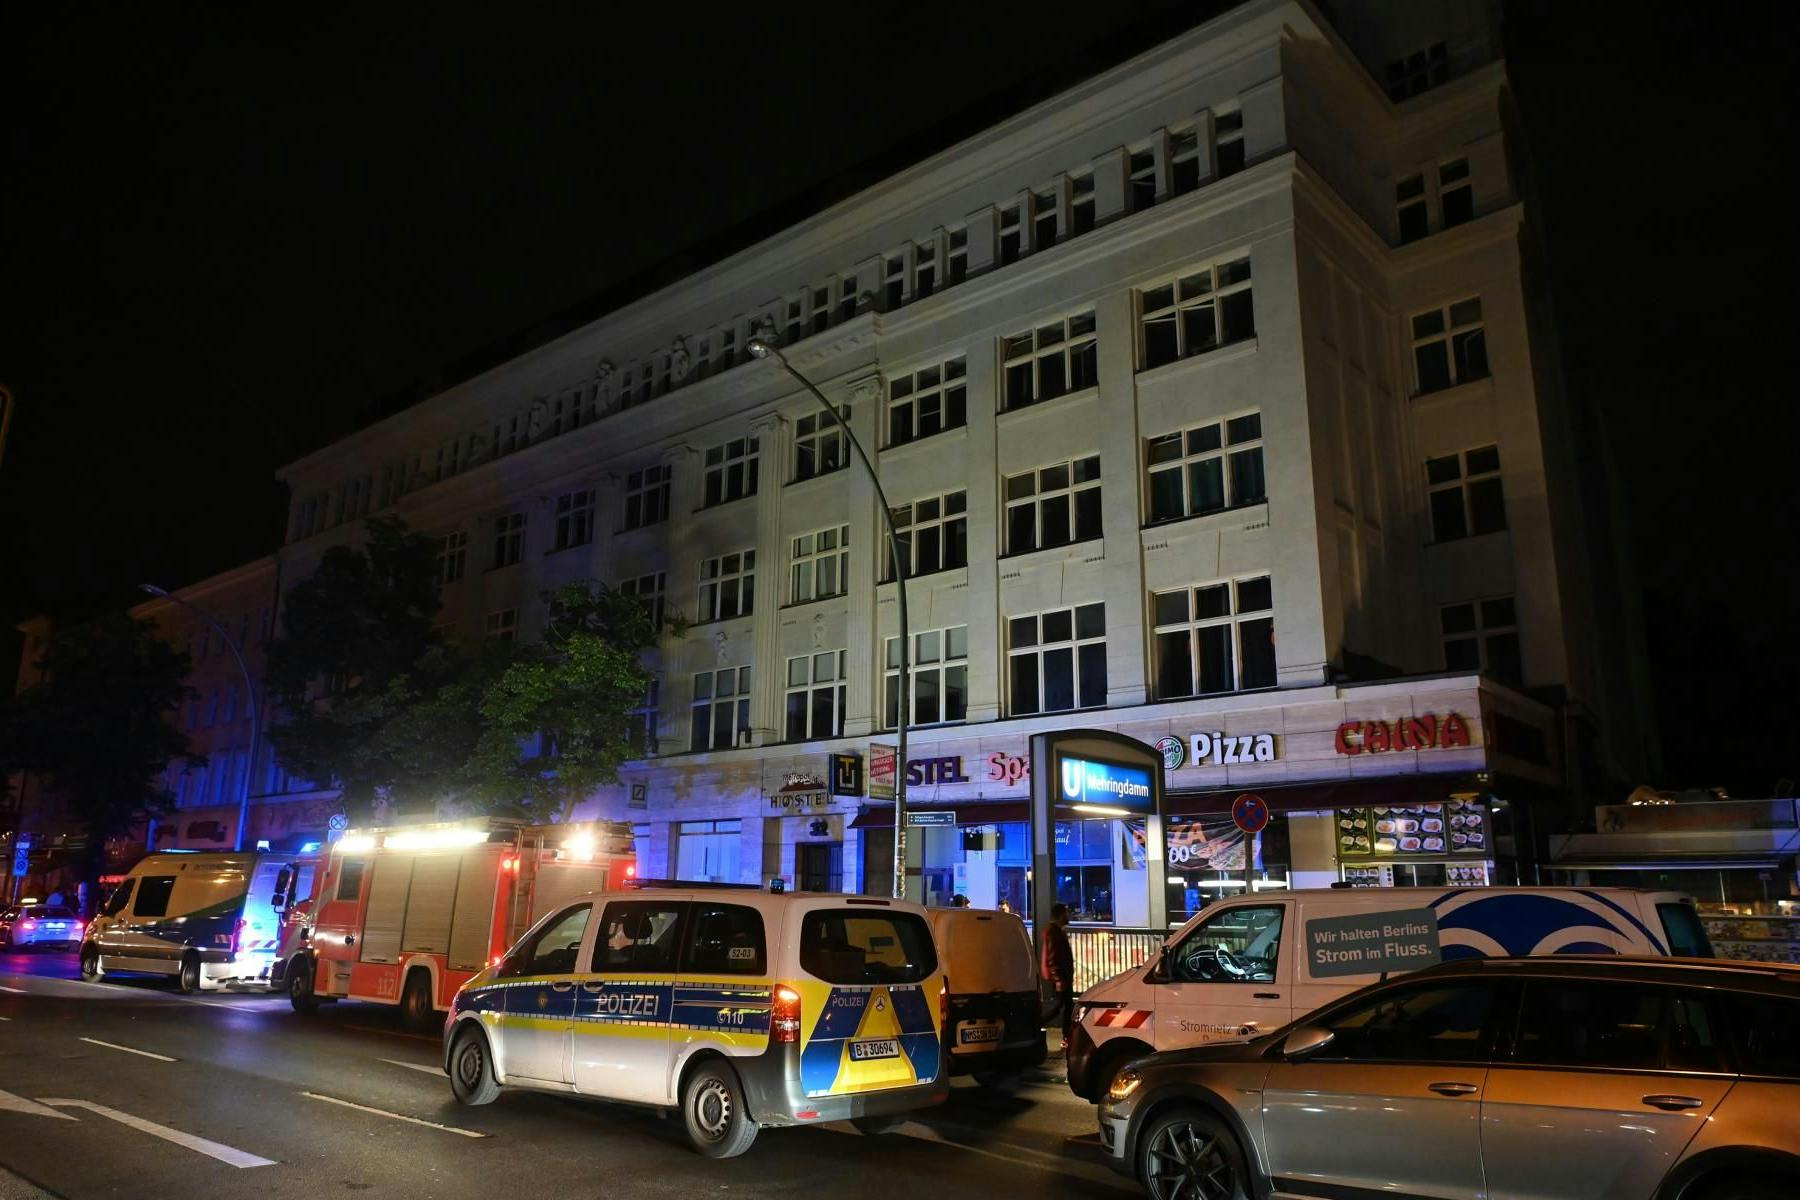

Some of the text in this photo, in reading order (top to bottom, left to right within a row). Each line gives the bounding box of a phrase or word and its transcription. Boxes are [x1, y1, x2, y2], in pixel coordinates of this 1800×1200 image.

[1335, 712, 1470, 755] CHINA
[1190, 732, 1275, 766] Pizza
[1062, 761, 1149, 798] U Mehringdamm
[770, 792, 835, 809] HOSTEL
[1314, 923, 1429, 944] Wir halten Berlins
[731, 948, 751, 958] 52-03
[1316, 942, 1432, 964] Strom im Fluss.
[596, 993, 659, 1016] POLIZEI
[832, 996, 864, 1007] POLIZEI
[726, 1012, 744, 1025] 110
[1180, 1019, 1233, 1035] Stromnetz
[856, 1042, 894, 1056] B 30694
